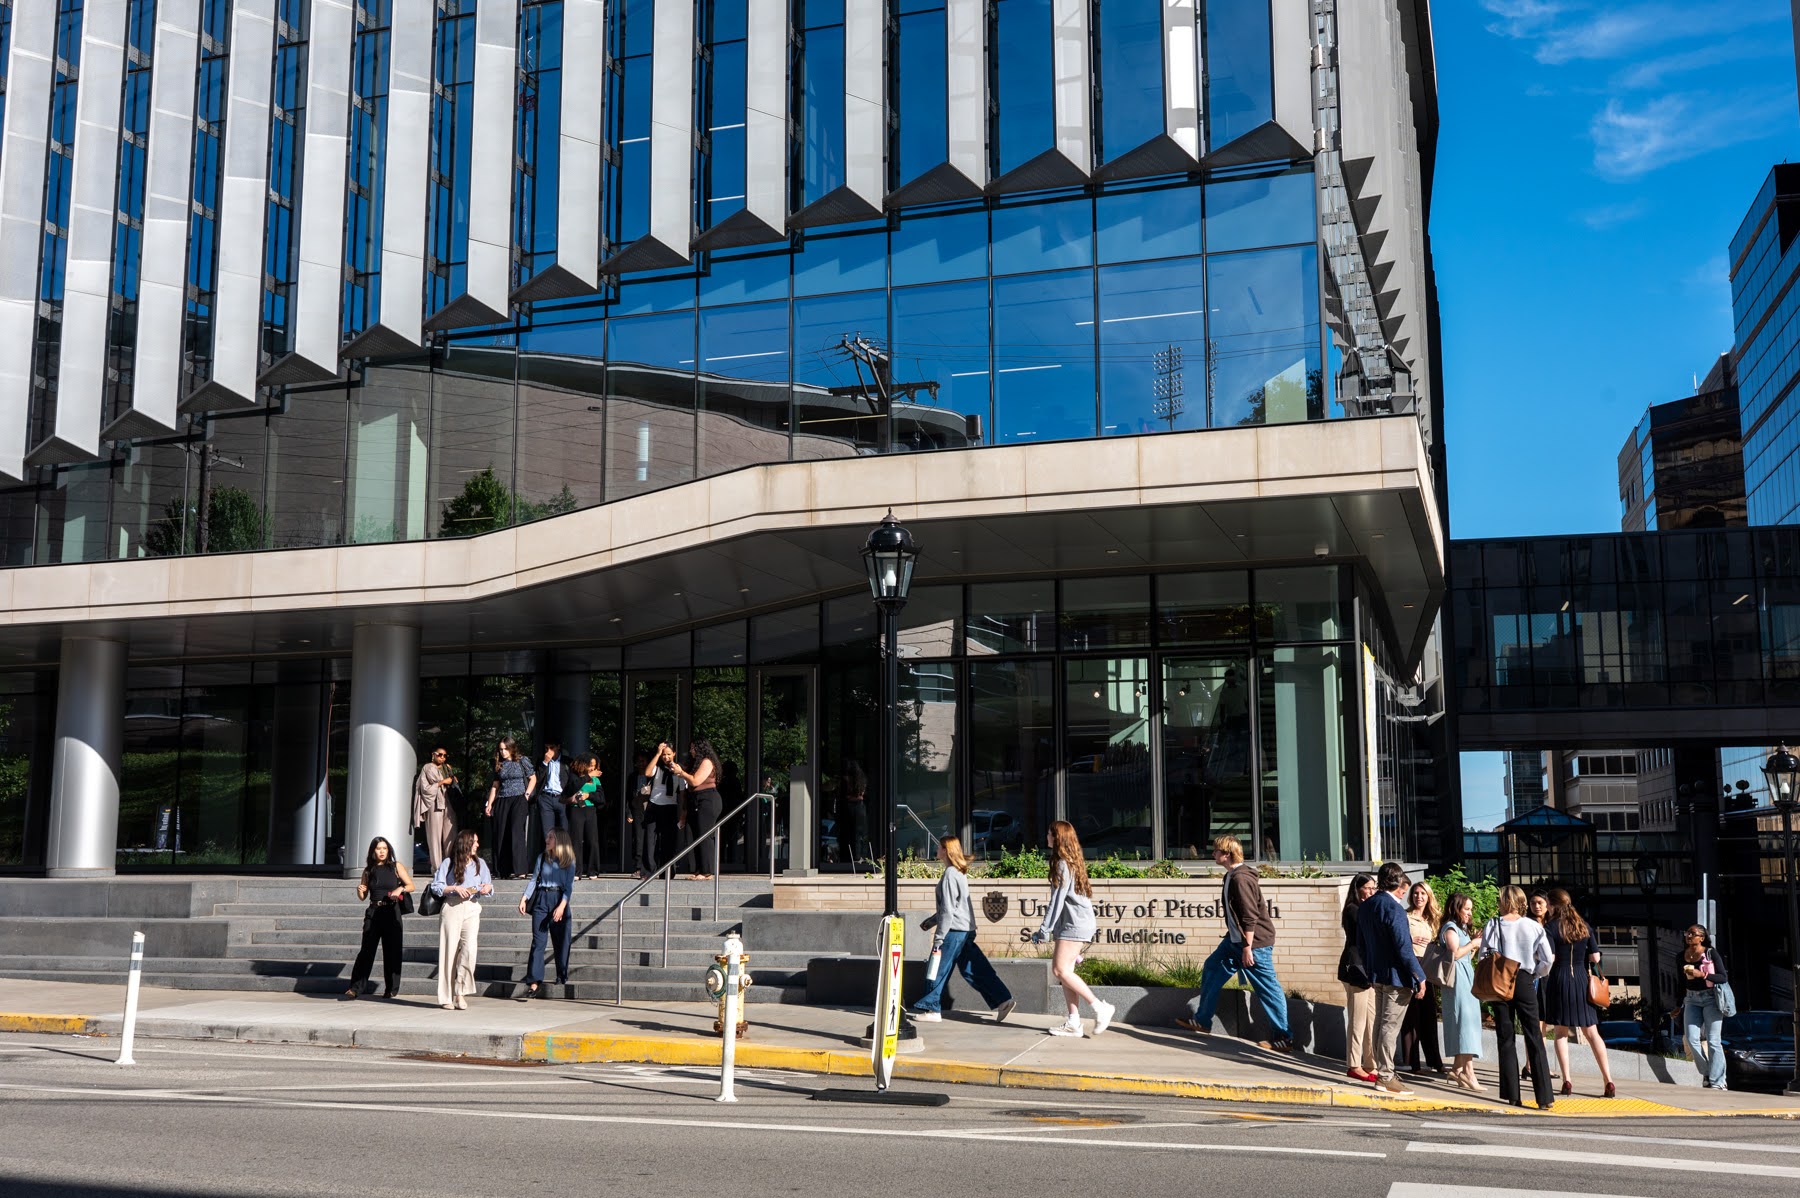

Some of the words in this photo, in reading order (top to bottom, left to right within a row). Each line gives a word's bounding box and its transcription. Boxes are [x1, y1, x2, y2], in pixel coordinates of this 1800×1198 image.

[1018, 898, 1127, 923] Unsity
[1133, 899, 1157, 918] of
[1164, 899, 1281, 919] Pittsbh
[1107, 928, 1186, 945] Medicine
